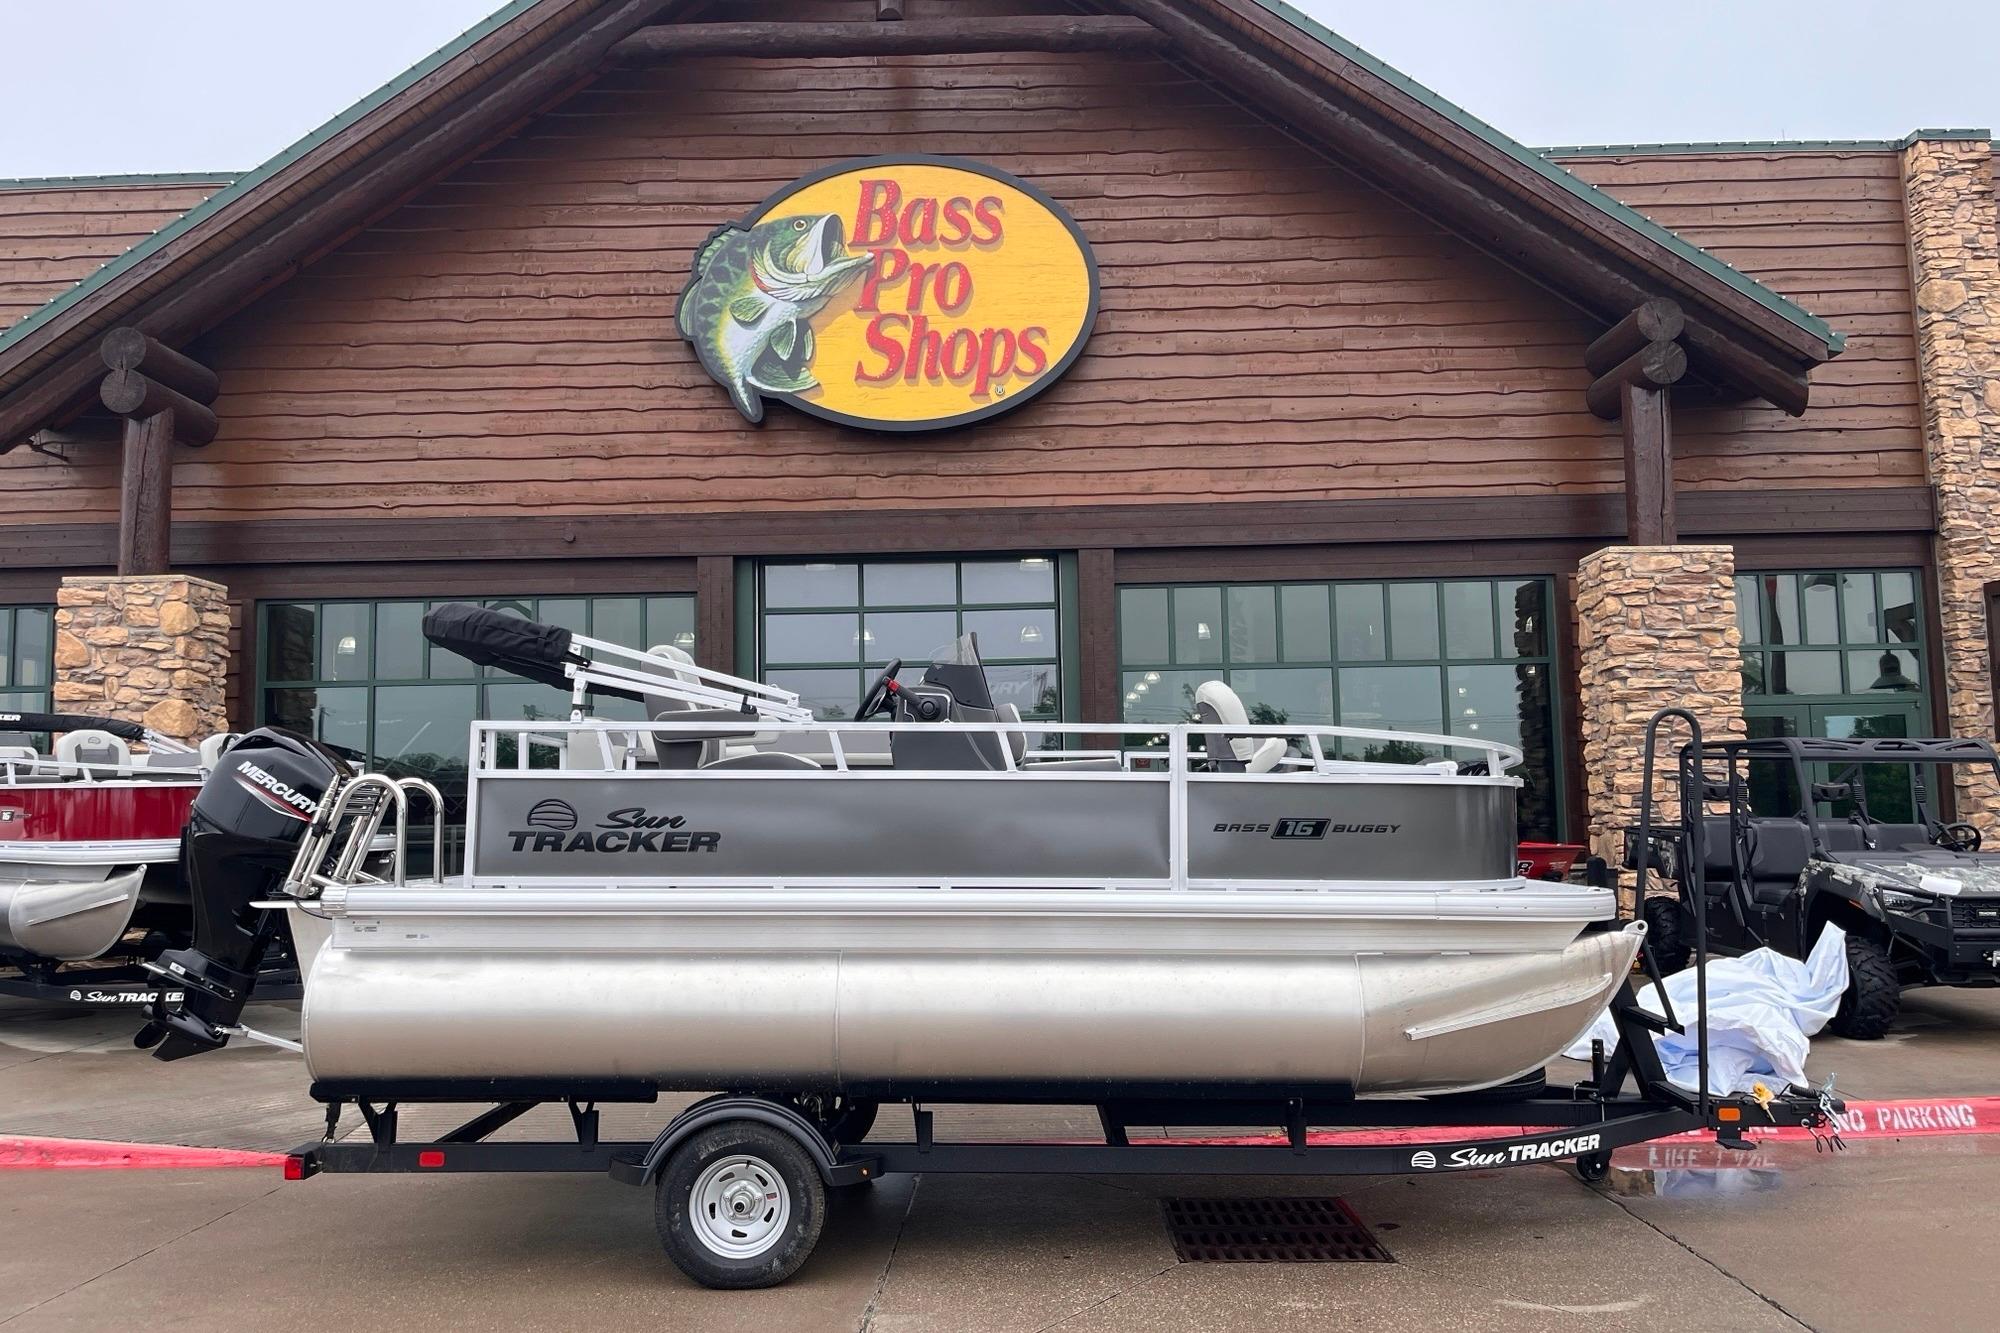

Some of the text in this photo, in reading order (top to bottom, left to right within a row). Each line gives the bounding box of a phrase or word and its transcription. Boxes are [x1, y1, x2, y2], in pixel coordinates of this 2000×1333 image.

[846, 179, 1003, 246] Bass
[853, 248, 974, 312] Pro
[855, 313, 1048, 398] Shops
[236, 760, 320, 814] MERCURY
[595, 807, 688, 829] Sun
[1213, 821, 1402, 836] BASS 16 BUGGY
[507, 831, 722, 853] TRACKER
[84, 990, 118, 1003] Sun
[1876, 1104, 1976, 1132] PARKING
[1443, 1133, 1601, 1167] Sun TRACKER
